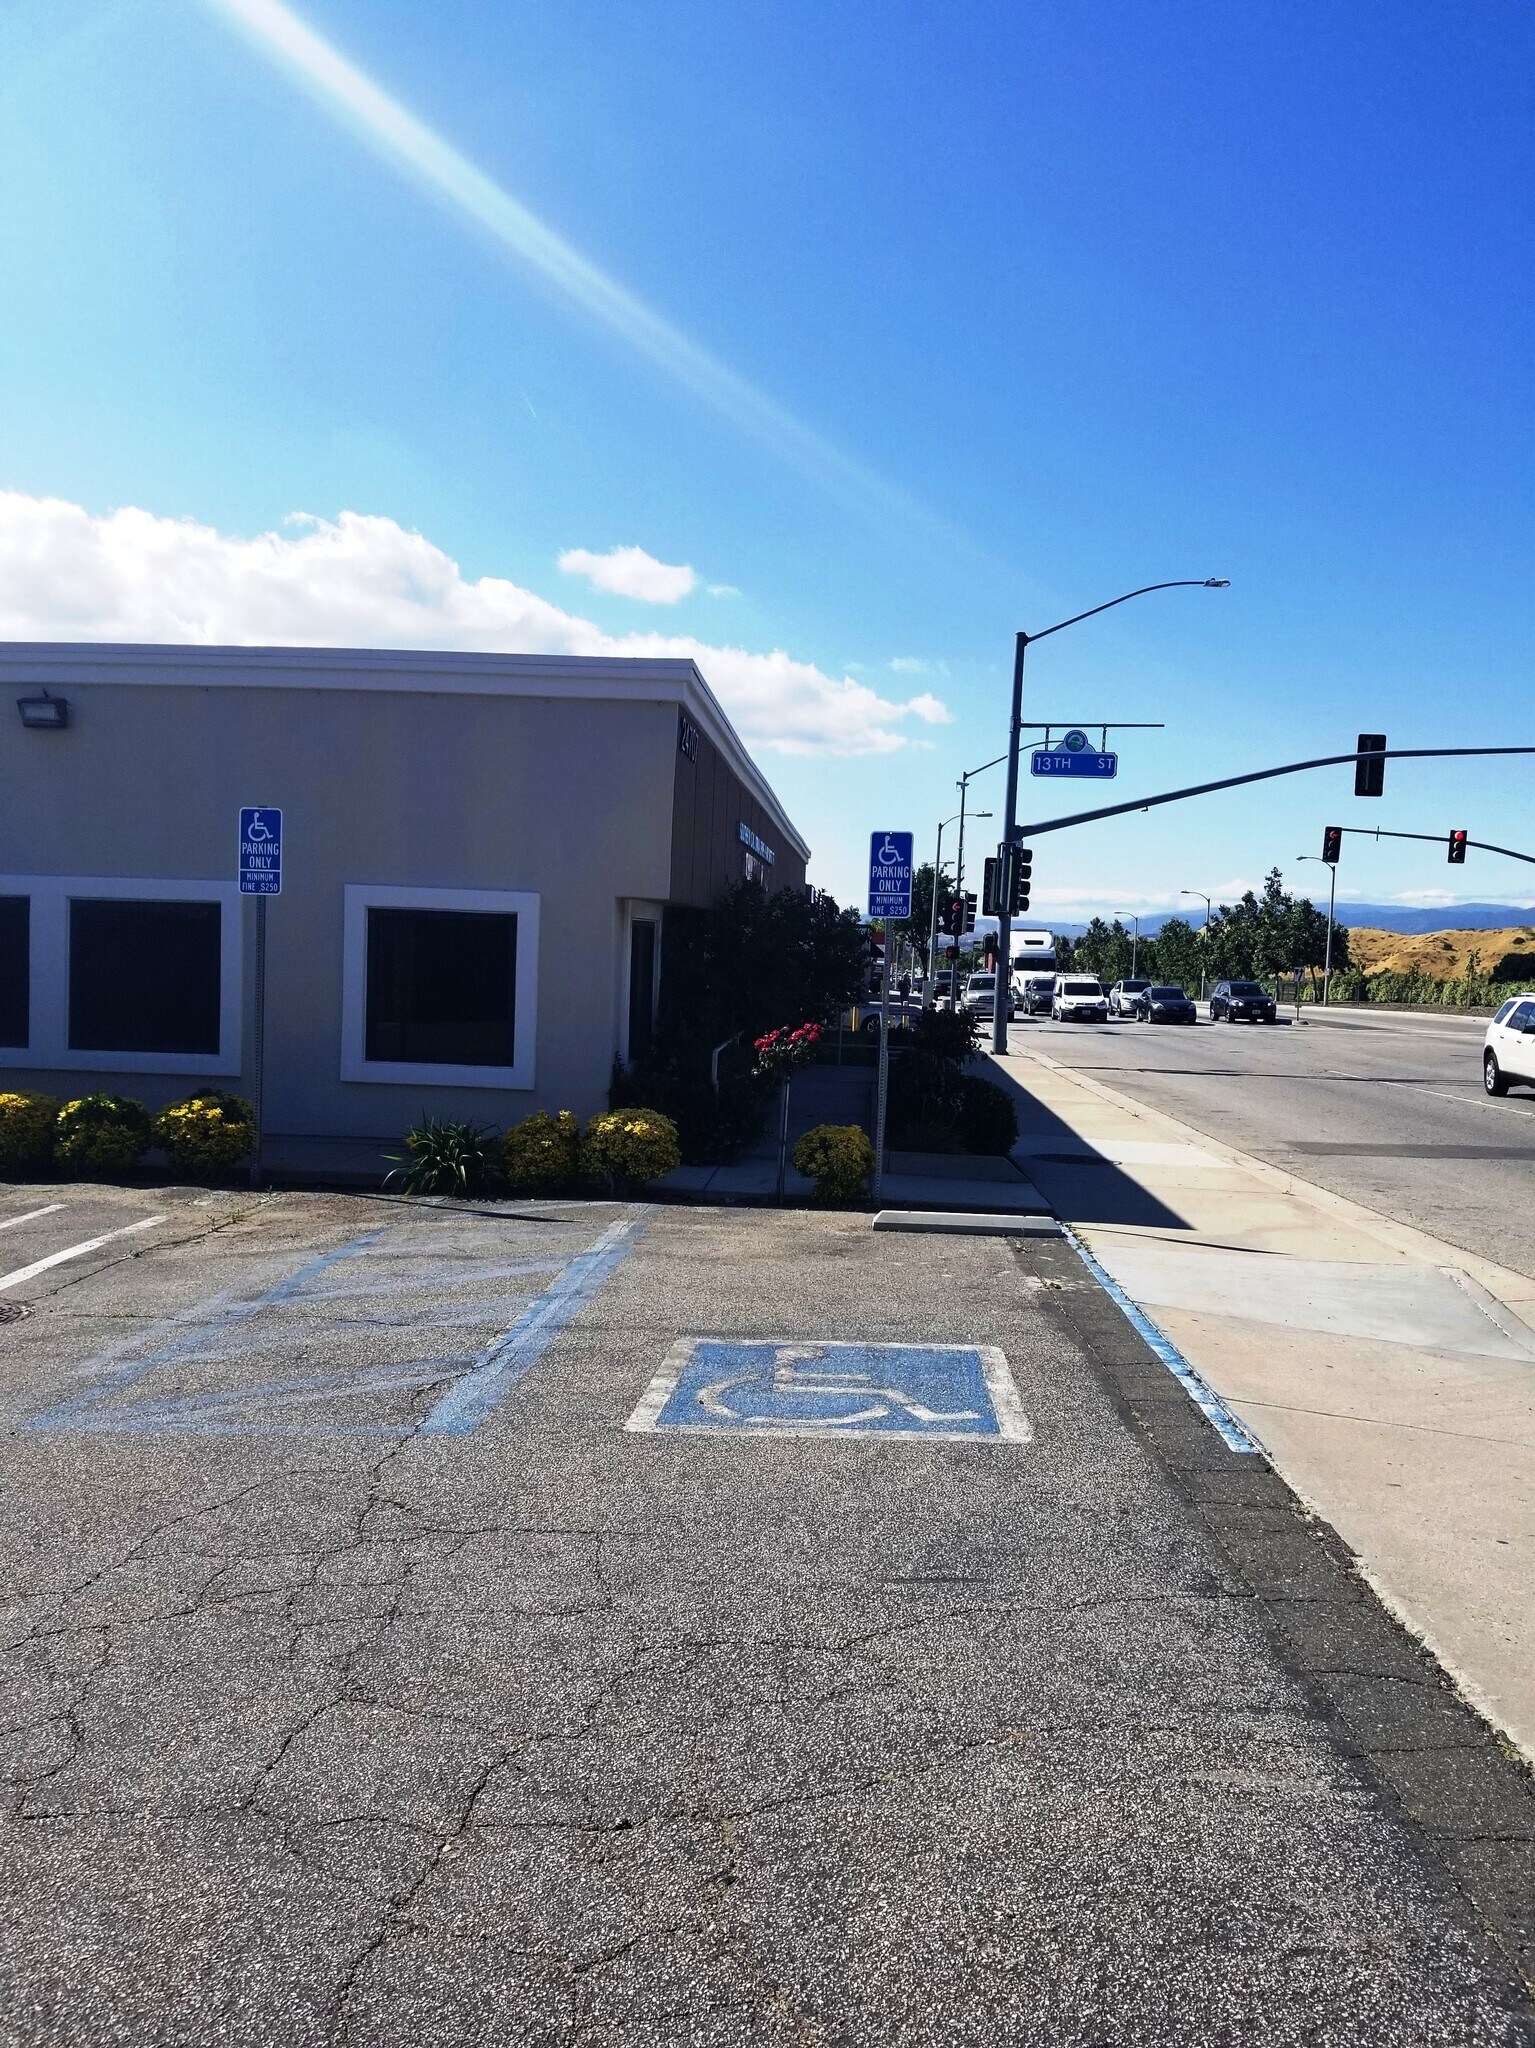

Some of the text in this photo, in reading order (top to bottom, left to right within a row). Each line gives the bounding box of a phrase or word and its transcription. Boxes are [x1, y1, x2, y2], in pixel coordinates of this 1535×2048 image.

[1036, 757, 1114, 771] 13TH ST
[242, 842, 279, 855] PARKING
[249, 856, 272, 868] ONLY
[246, 872, 274, 881] MINIMUM
[872, 866, 909, 878] PARKING
[242, 882, 278, 892] FINE $250
[879, 879, 902, 892] ONLY
[875, 896, 903, 905] MINIMUM
[871, 905, 907, 915] FINE $250
